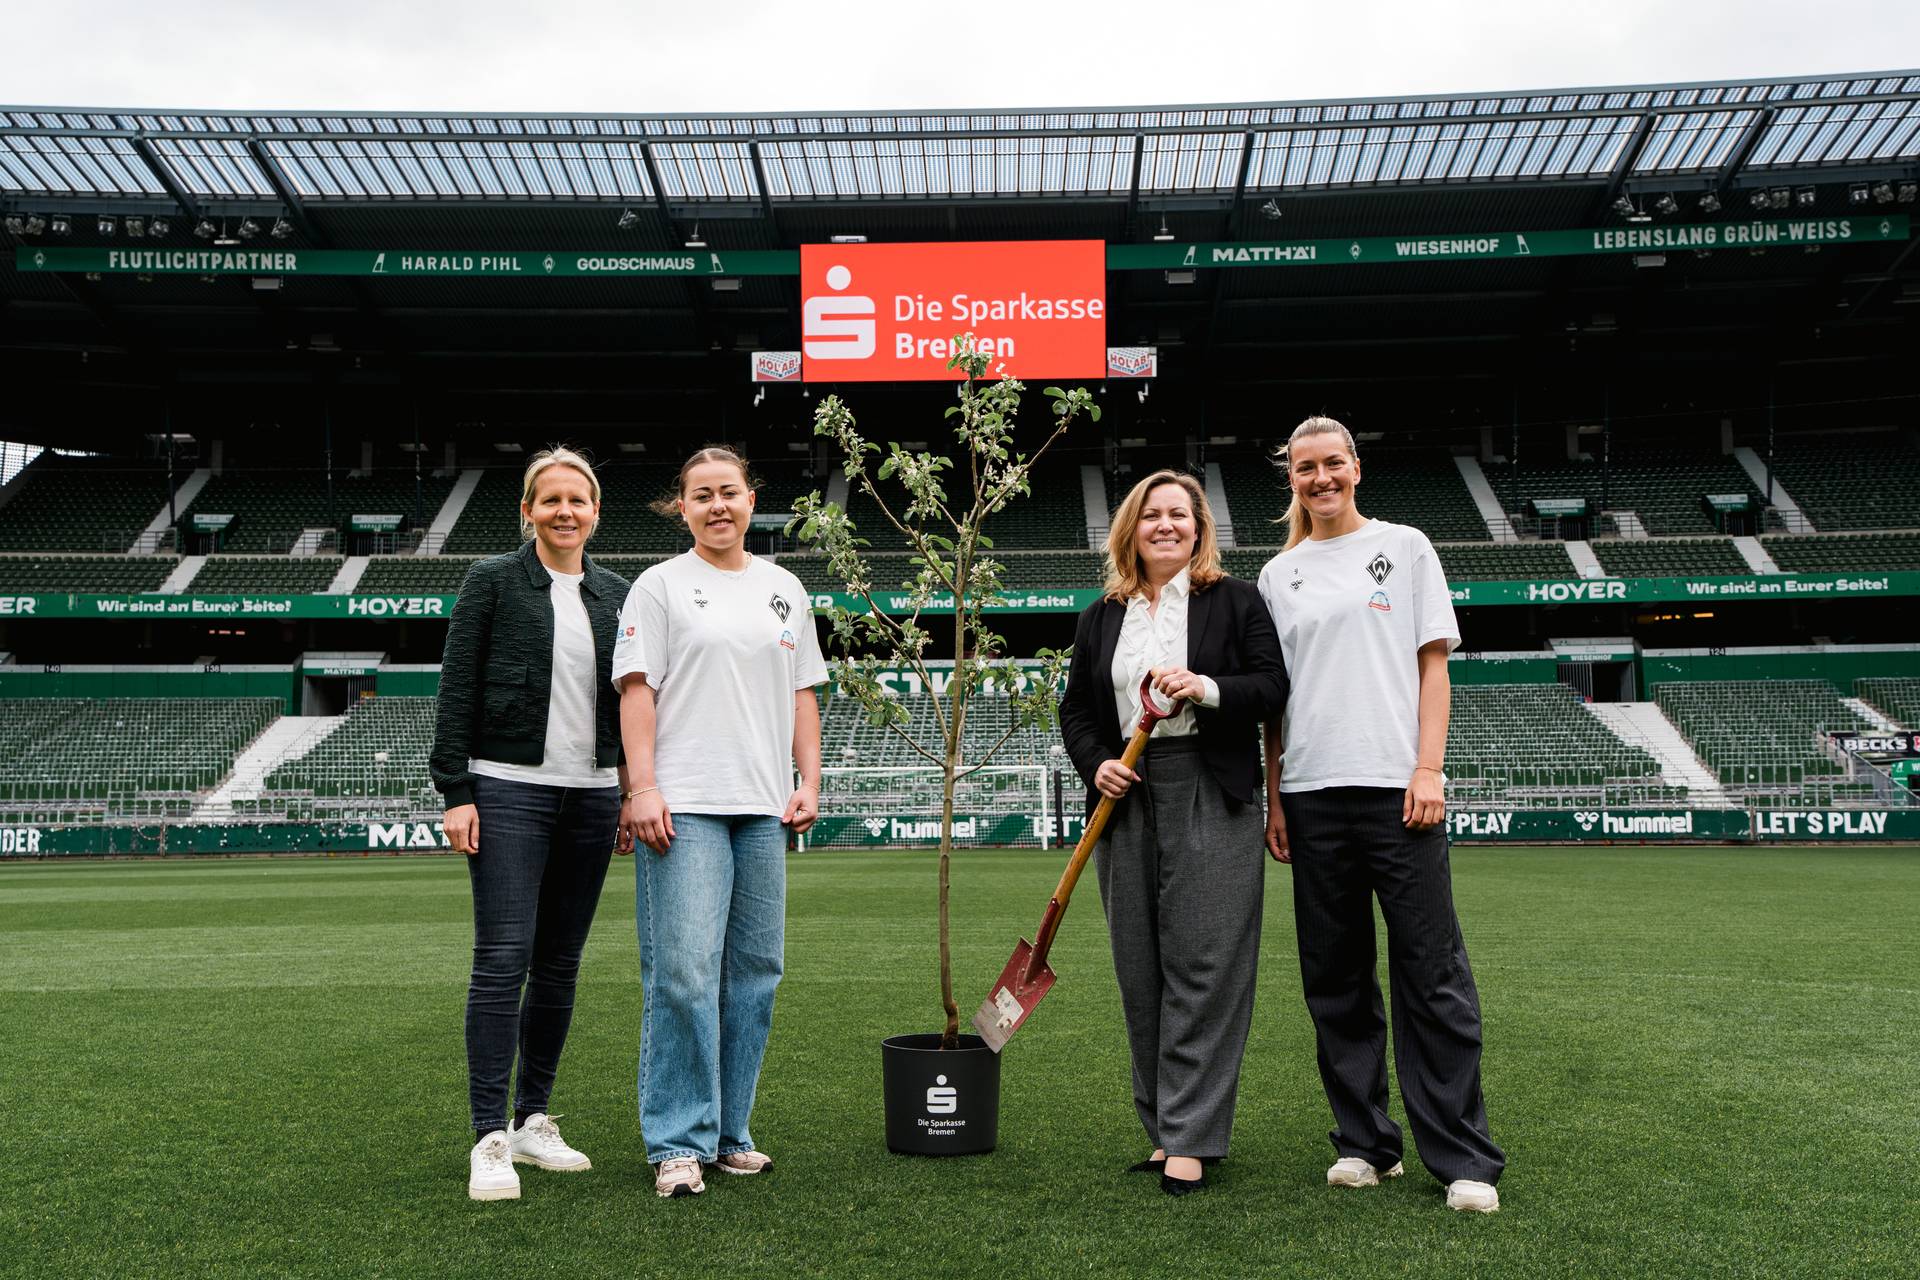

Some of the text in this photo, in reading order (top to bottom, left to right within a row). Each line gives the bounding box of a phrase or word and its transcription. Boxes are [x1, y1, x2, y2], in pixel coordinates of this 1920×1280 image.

[1594, 221, 1851, 249] LEBENSLANG GRÜN-WEISS
[1213, 246, 1316, 262] MATTHÄI
[1395, 239, 1499, 256] WIESENHOF
[109, 251, 297, 270] FLUTLICHTPARTNER
[401, 256, 522, 271] HARALD PIHL
[577, 257, 695, 271] GOLDSCHMAUS
[895, 292, 1104, 327] Die Sparkasse
[1529, 582, 1626, 600] HOYER
[1686, 578, 1889, 594] Wir sind an Eurer Seite!
[97, 600, 127, 612] Wir
[129, 600, 165, 612] sind
[168, 603, 189, 612] an
[348, 598, 443, 615] HOYER
[1026, 595, 1074, 608] Seite!
[1843, 737, 1908, 751] BECK'S
[1455, 812, 1512, 834] PLAY
[1602, 812, 1693, 834] hummel
[1756, 812, 1888, 834] LET'S PLAY
[0, 828, 41, 853] DER
[917, 1119, 966, 1128] Die Sparkasse
